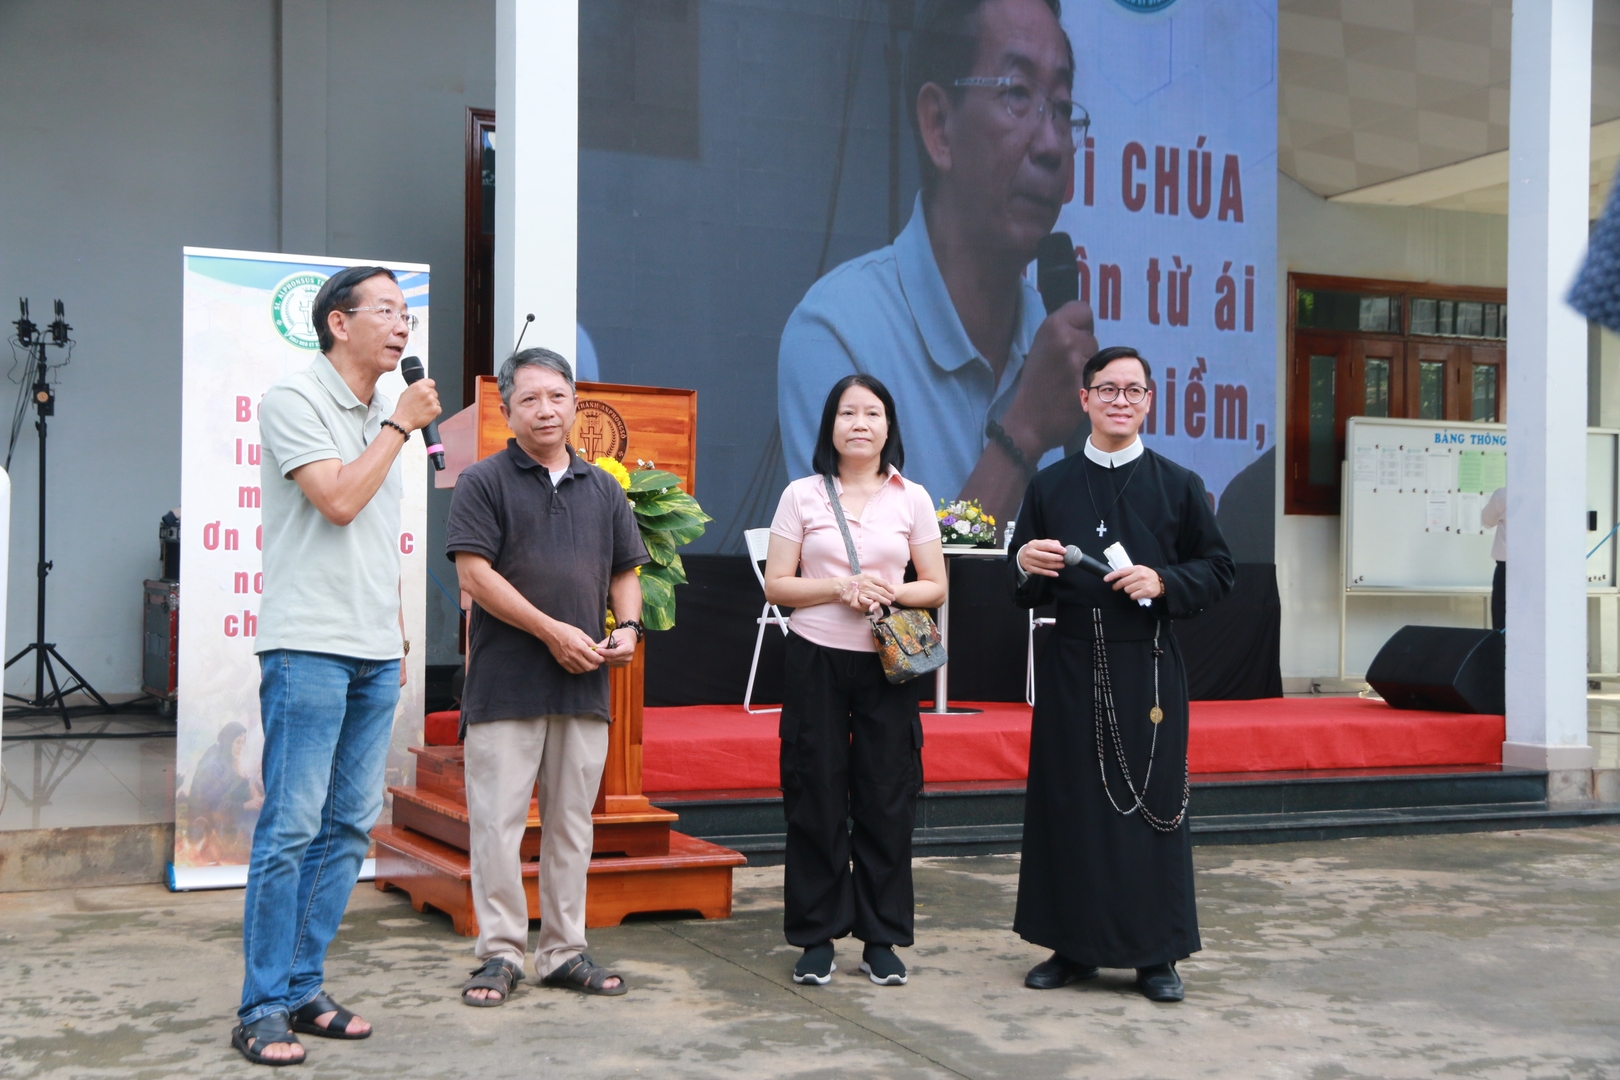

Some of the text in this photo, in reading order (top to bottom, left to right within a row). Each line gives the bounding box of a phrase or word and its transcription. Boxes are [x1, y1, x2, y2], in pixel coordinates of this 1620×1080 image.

[1121, 135, 1244, 223] CHÚA
[278, 277, 315, 299] ALPHONSUS
[1146, 255, 1193, 327] từ
[1214, 260, 1255, 333] ái
[1434, 428, 1507, 446] BẢNG THÔNG
[203, 520, 240, 551] Ơn
